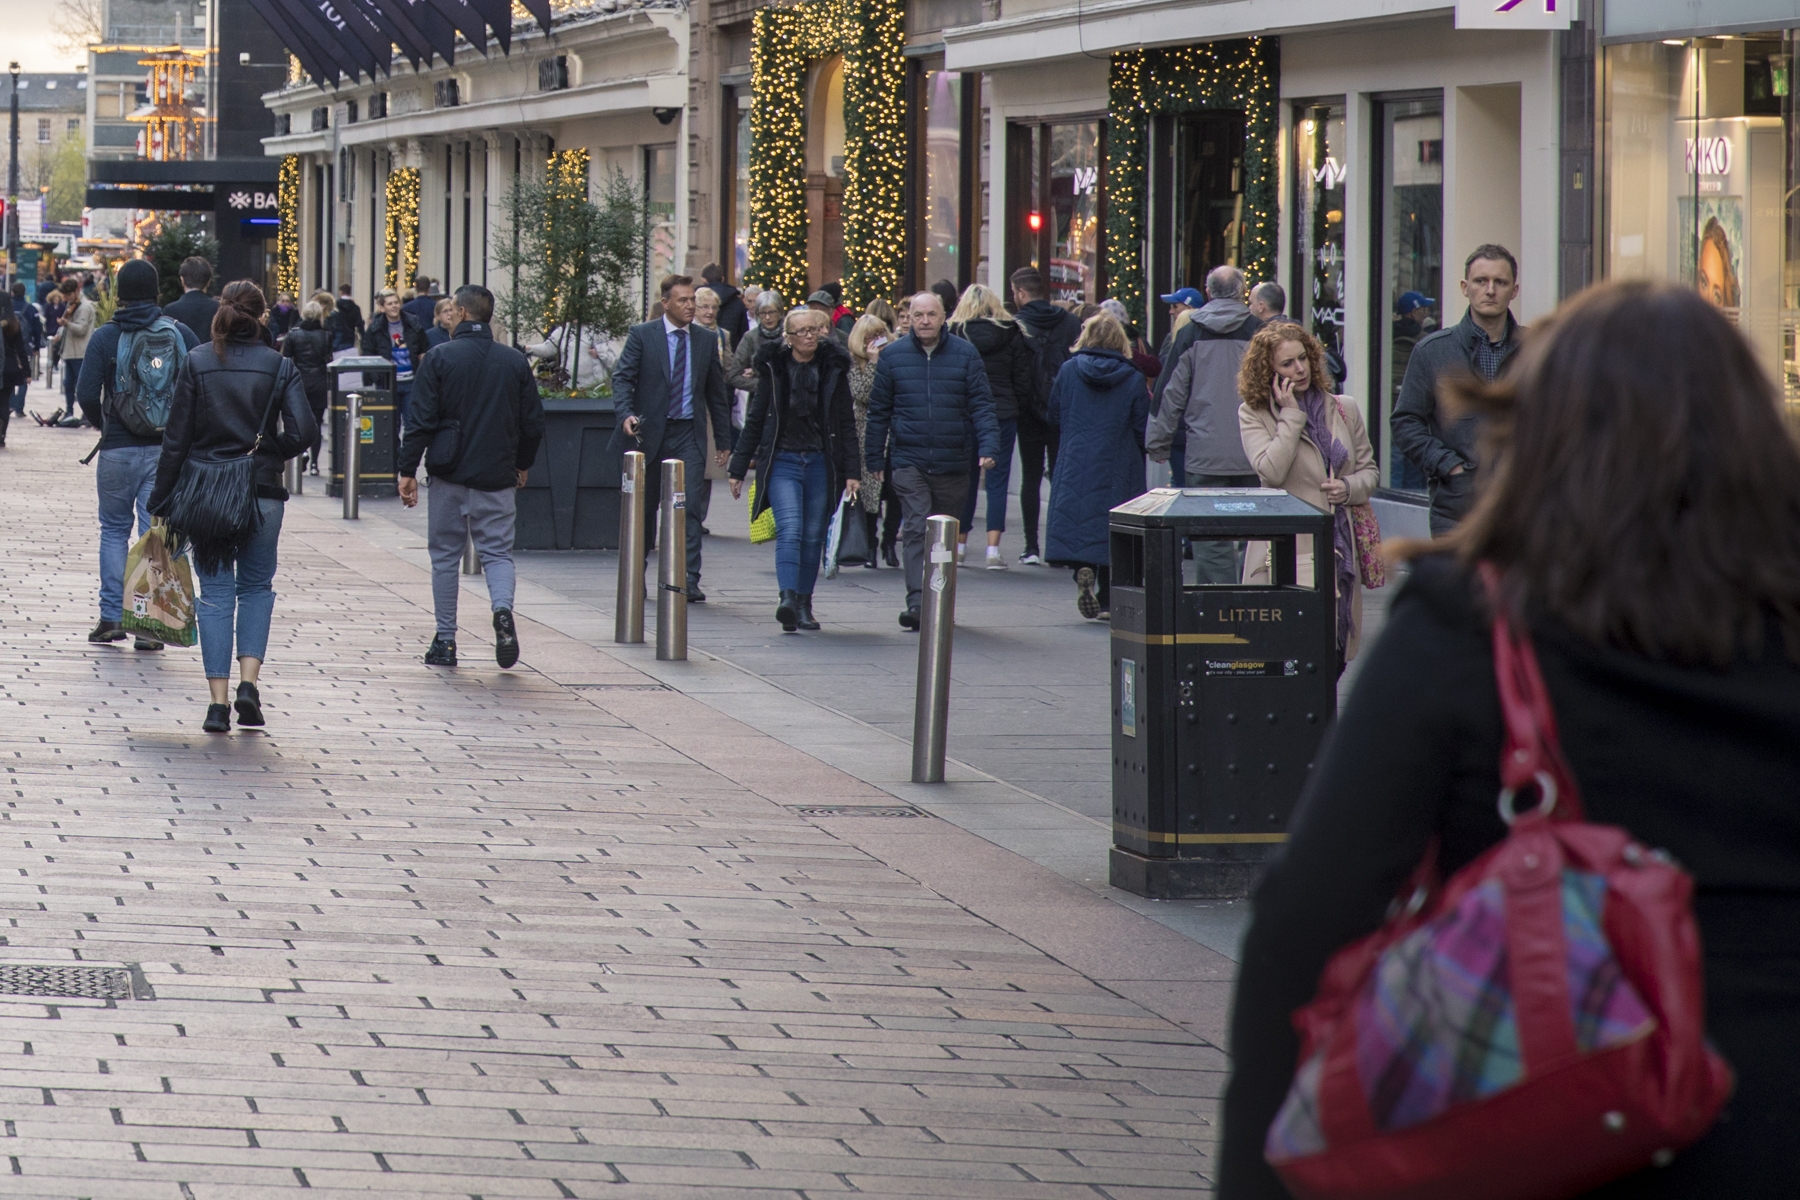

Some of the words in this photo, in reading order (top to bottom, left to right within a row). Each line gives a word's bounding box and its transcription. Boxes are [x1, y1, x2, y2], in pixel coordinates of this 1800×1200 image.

[1685, 137, 1732, 175] KIKO
[1218, 608, 1283, 622] LITTER
[1209, 661, 1265, 669] cleanglasgow
